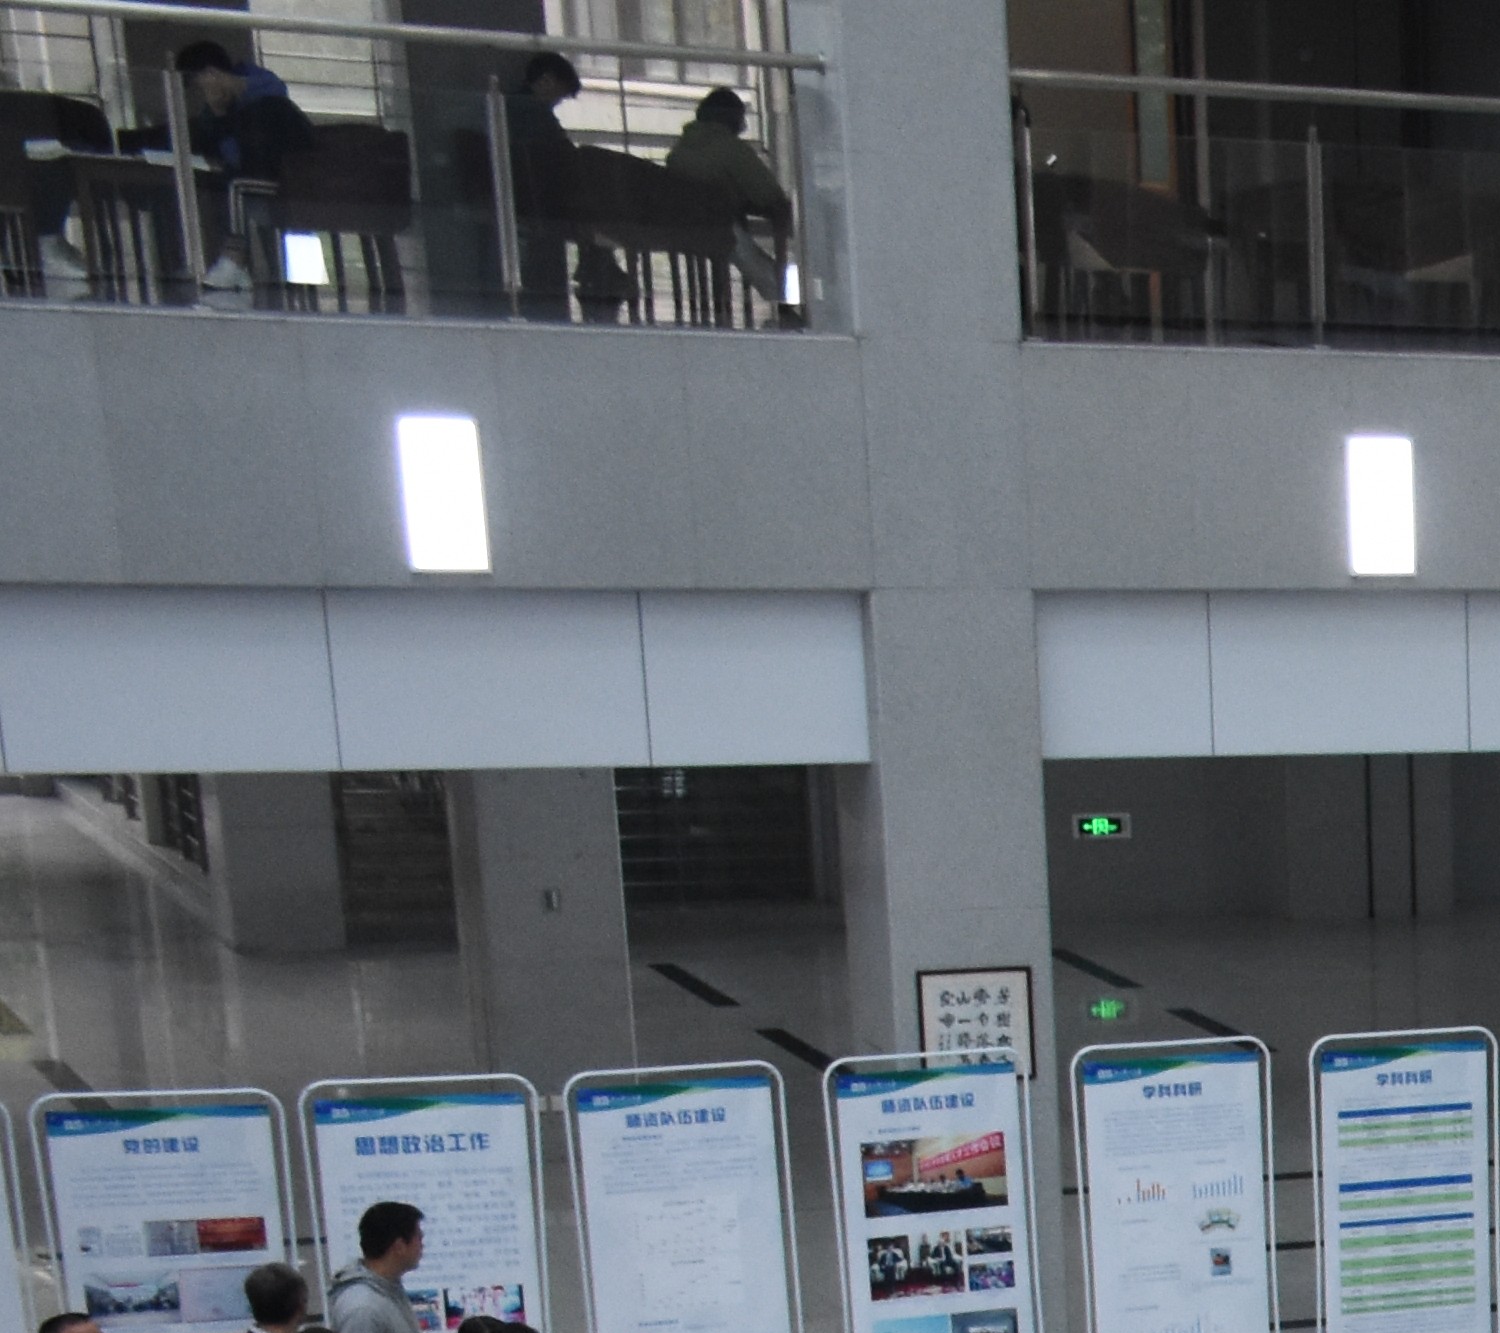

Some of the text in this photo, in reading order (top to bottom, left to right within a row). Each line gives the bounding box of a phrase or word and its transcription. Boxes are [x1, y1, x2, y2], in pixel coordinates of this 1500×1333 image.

[122, 1134, 202, 1156] 党的建设
[354, 1131, 492, 1157] 思想政治工作
